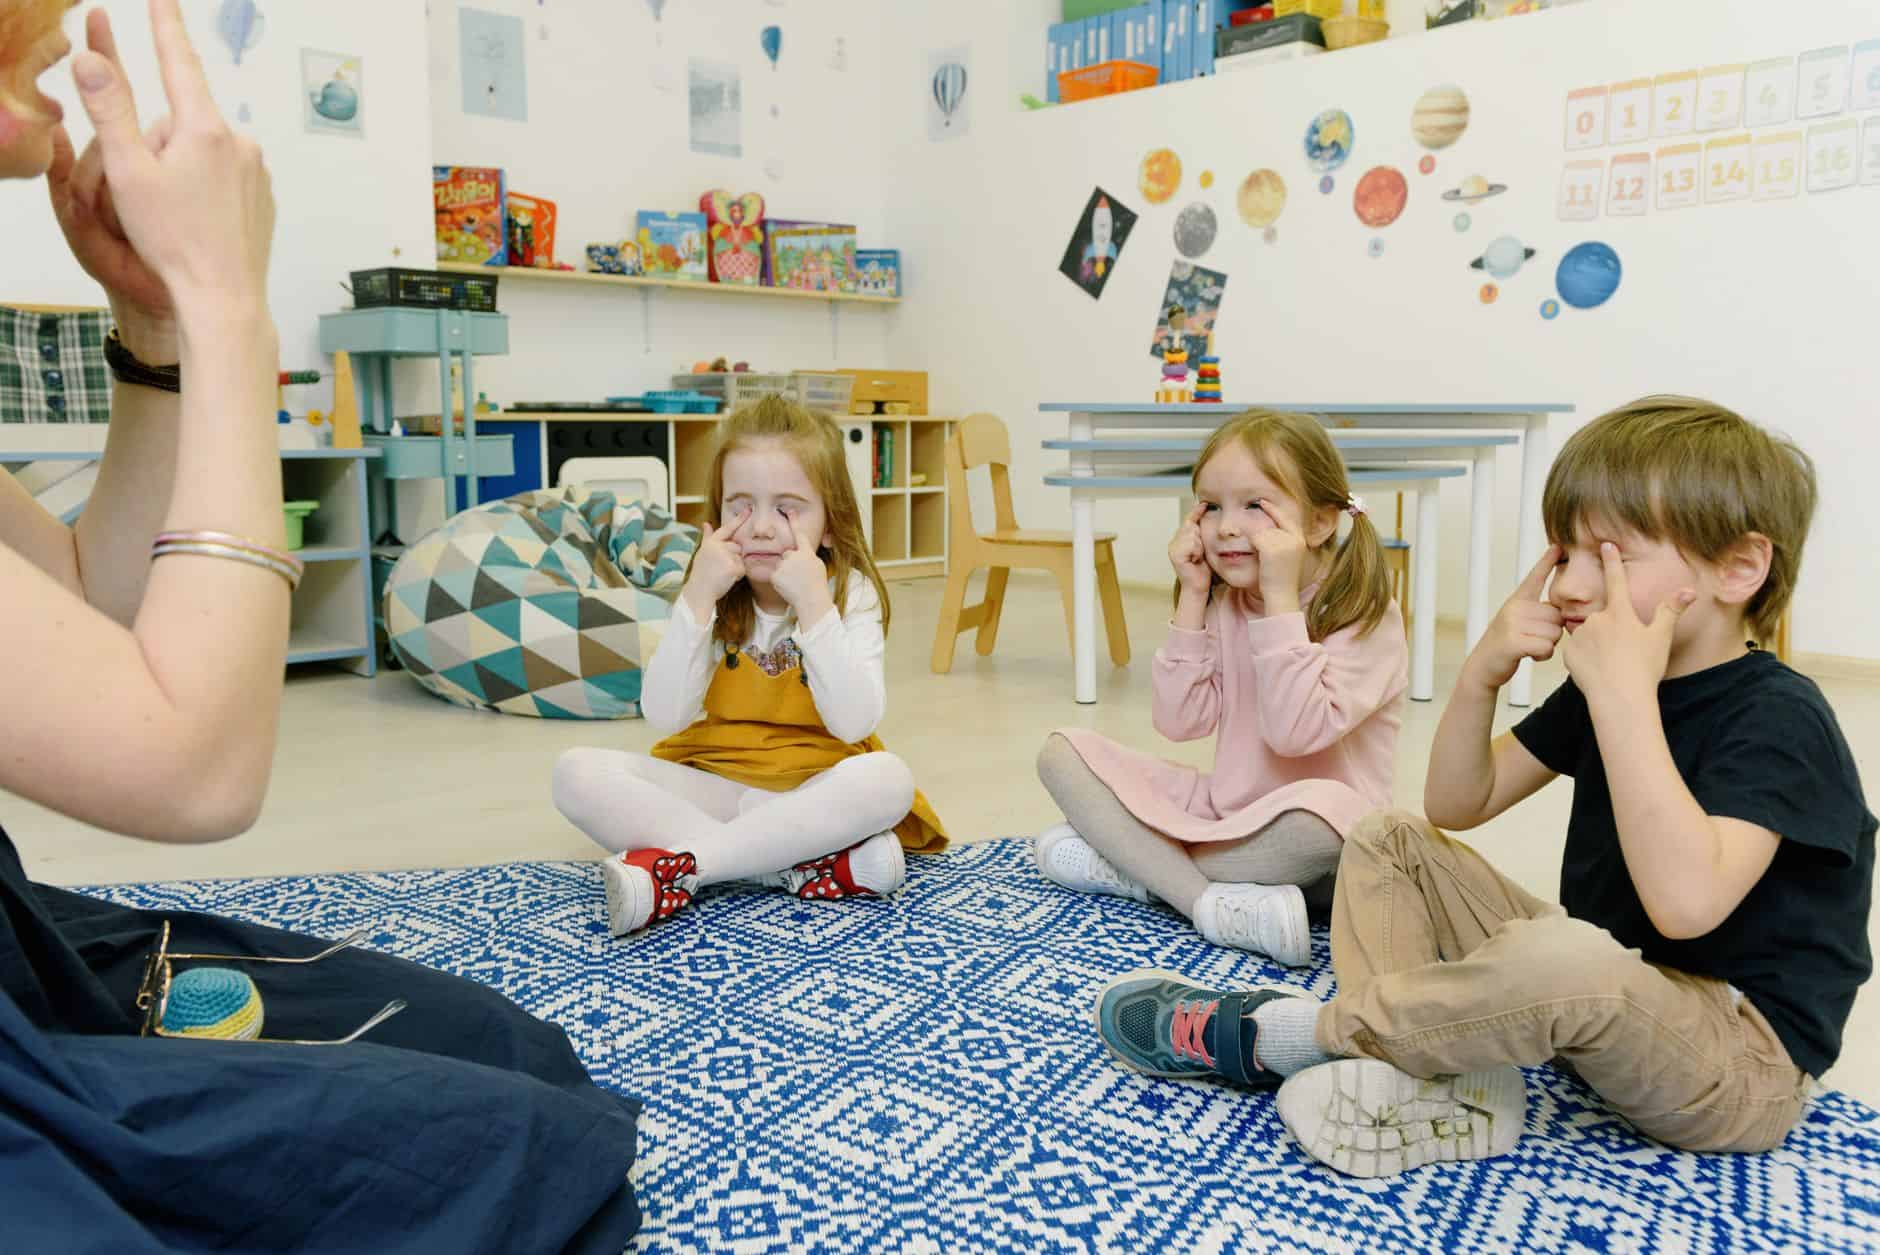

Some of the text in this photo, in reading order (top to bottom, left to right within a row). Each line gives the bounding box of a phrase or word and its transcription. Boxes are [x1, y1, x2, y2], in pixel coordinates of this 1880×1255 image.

[1575, 111, 1594, 134] 0
[1623, 104, 1636, 128] 1
[1666, 97, 1681, 120] 2
[1711, 89, 1728, 114] 3
[1812, 71, 1832, 101] 5
[1566, 183, 1592, 206] 11
[1615, 177, 1643, 200] 12
[1664, 168, 1695, 193] 13
[1712, 160, 1745, 187] 14
[1759, 157, 1793, 184] 15
[1813, 147, 1850, 176] 16
